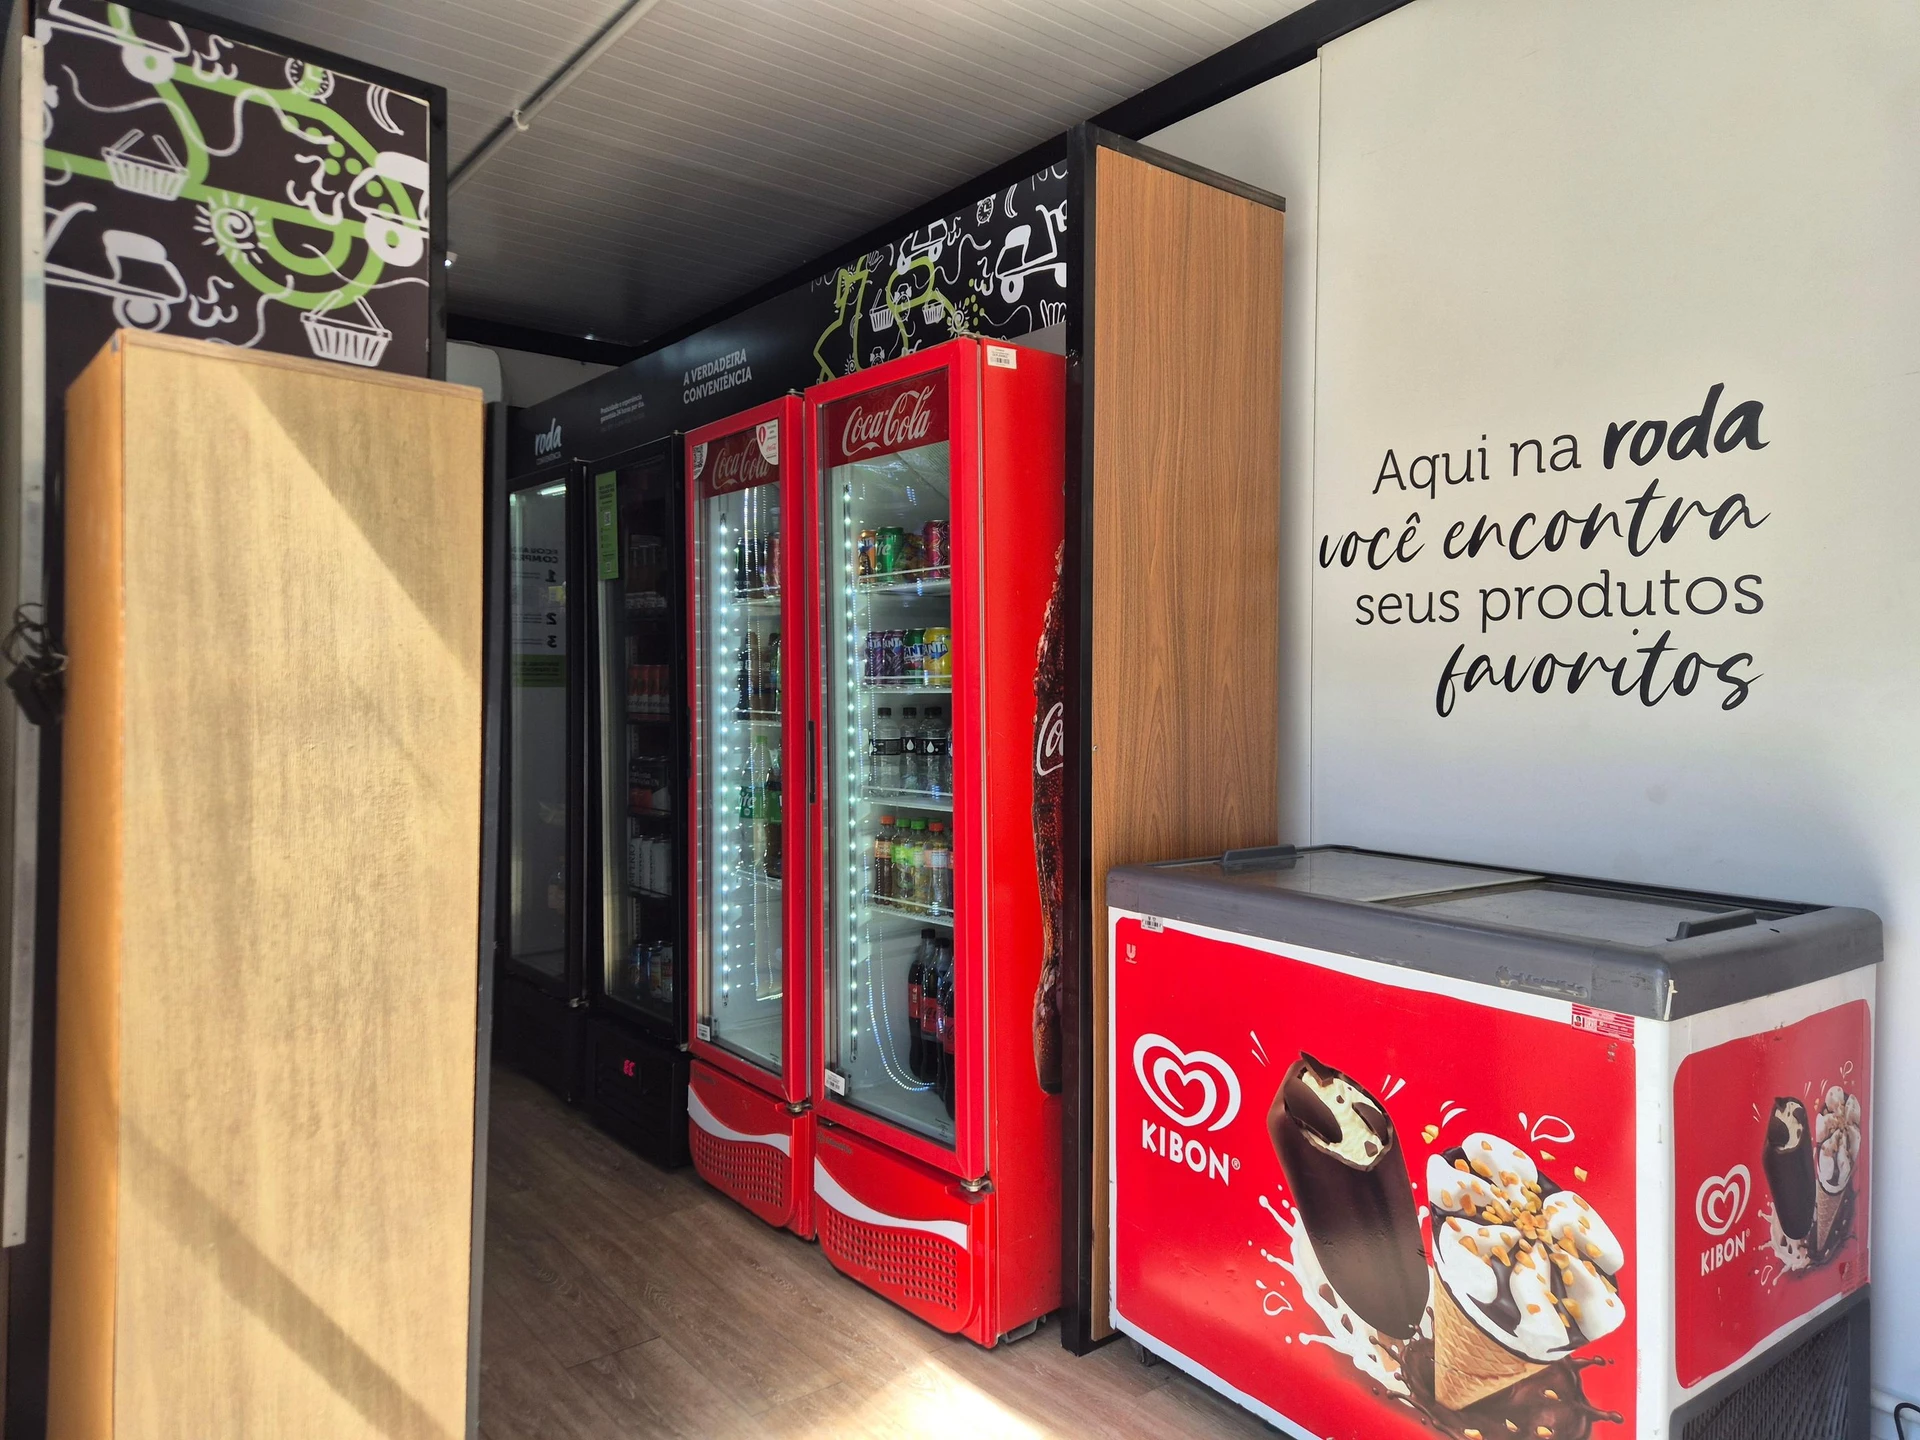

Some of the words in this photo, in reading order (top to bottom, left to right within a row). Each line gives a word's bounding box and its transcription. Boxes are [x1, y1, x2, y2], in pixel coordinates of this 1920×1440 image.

[683, 371, 690, 386] A
[691, 348, 747, 382] VERDADEIRA
[683, 365, 752, 404] CONVENIÊNCIA
[535, 417, 562, 456] roda
[841, 384, 936, 457] Coca-Cola
[1372, 434, 1490, 499] Aqui
[1509, 434, 1582, 477] na
[1603, 382, 1770, 470] roda
[1319, 511, 1425, 570] você
[1443, 478, 1772, 561] encontra
[1355, 587, 1460, 626] seus
[1479, 569, 1764, 633] produtos
[1435, 628, 1764, 718] favoritos
